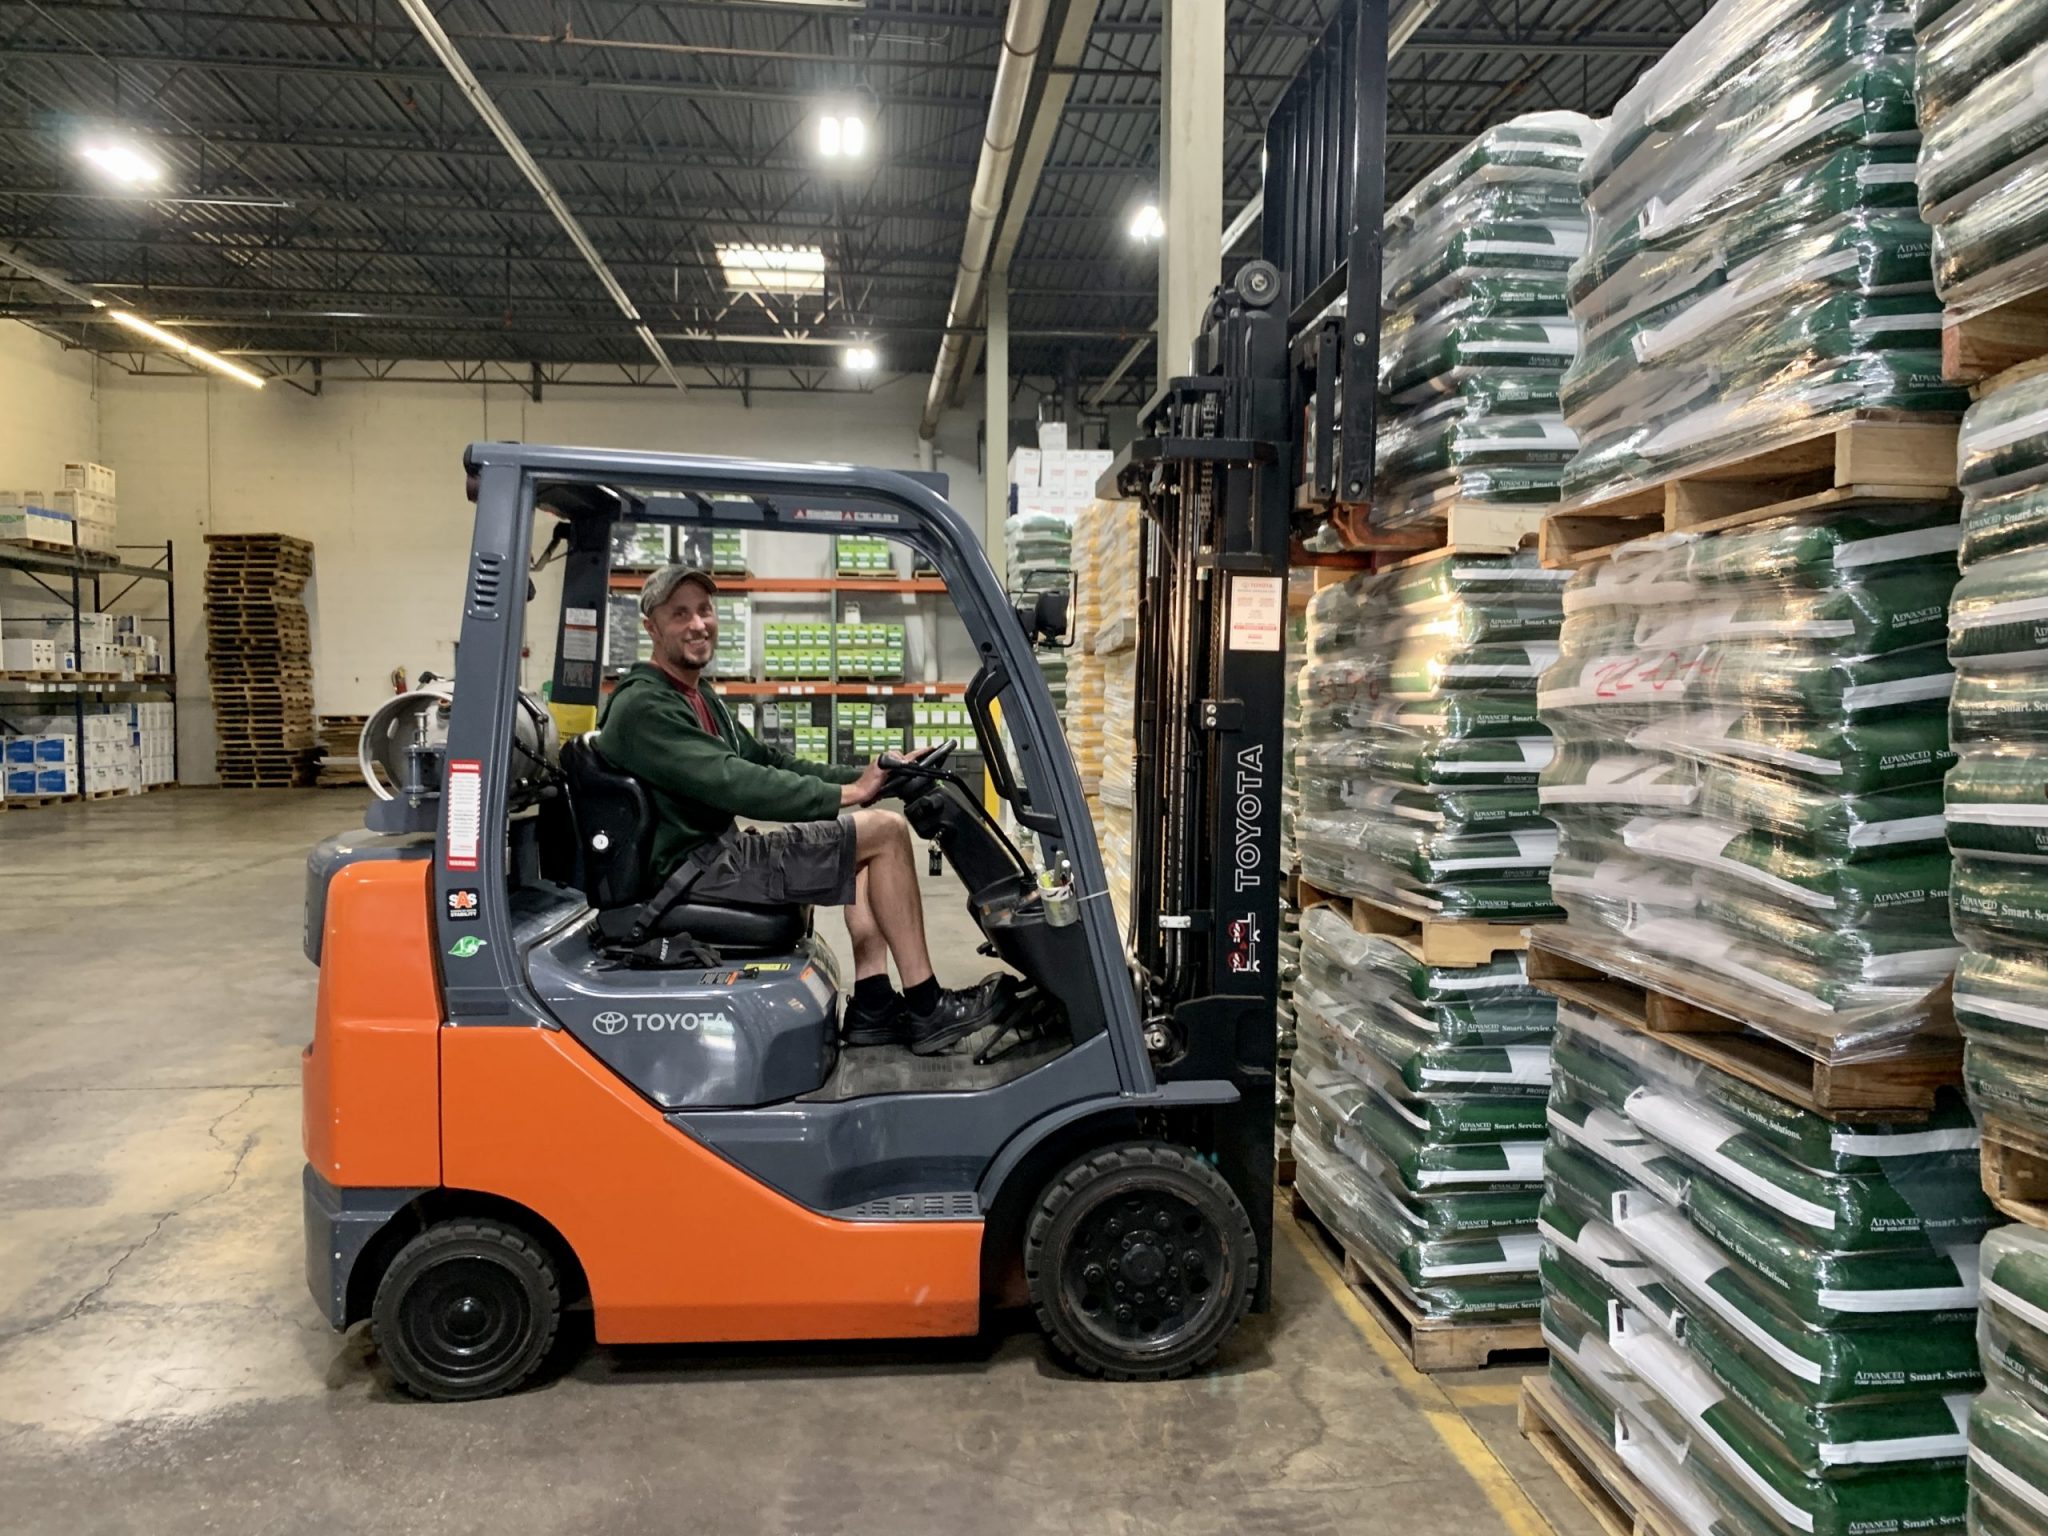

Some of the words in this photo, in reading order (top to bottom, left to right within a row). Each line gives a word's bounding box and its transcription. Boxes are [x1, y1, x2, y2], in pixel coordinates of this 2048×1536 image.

[1897, 244, 1932, 254] ADVAN
[1892, 606, 1941, 623] ADVANCED
[1880, 750, 1931, 765] ADVANCED
[1235, 744, 1263, 892] TOYOTA
[448, 891, 478, 909] SAS
[1874, 889, 1925, 903] ADVANCED
[1960, 894, 1998, 909] ADVANCED
[2001, 904, 2033, 919] Smart.
[632, 1012, 727, 1032] TOYOTA
[1768, 1119, 1802, 1140] Solutions.
[1871, 1217, 1920, 1227] ADVANCED
[1924, 1219, 1960, 1228] Smart.
[1758, 1260, 1791, 1290] Solutions.
[1856, 1371, 1904, 1380] ADVANCED
[1910, 1372, 1944, 1381] Smart.
[1850, 1520, 1898, 1530] ADVANCED
[1903, 1519, 1938, 1529] Smart.
